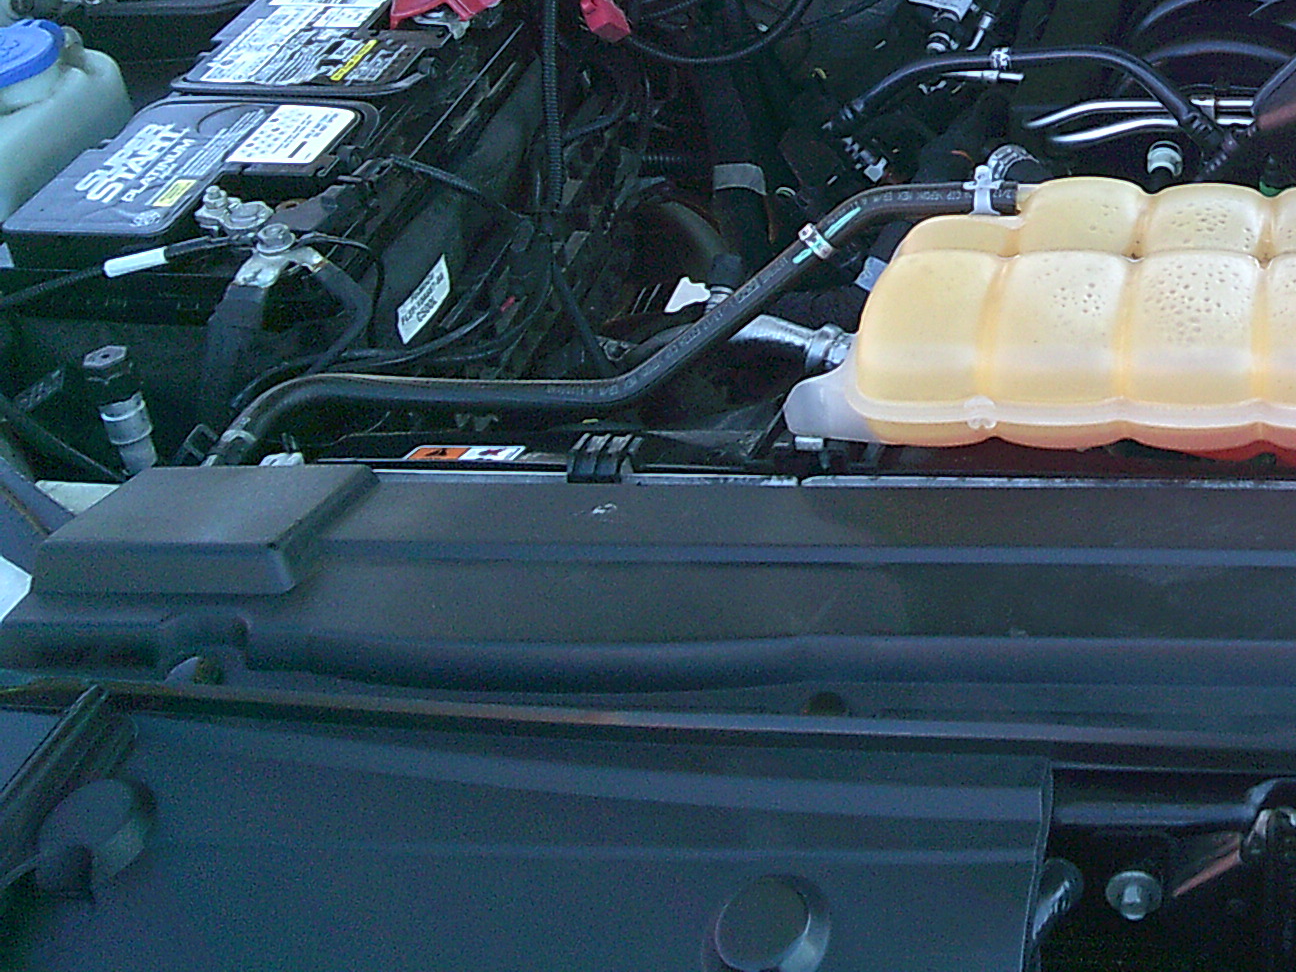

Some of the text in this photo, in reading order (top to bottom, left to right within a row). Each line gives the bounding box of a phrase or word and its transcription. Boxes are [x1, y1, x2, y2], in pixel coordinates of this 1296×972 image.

[75, 124, 167, 191] SUPER
[86, 124, 184, 203] START
[121, 138, 196, 202] PLATINUM
